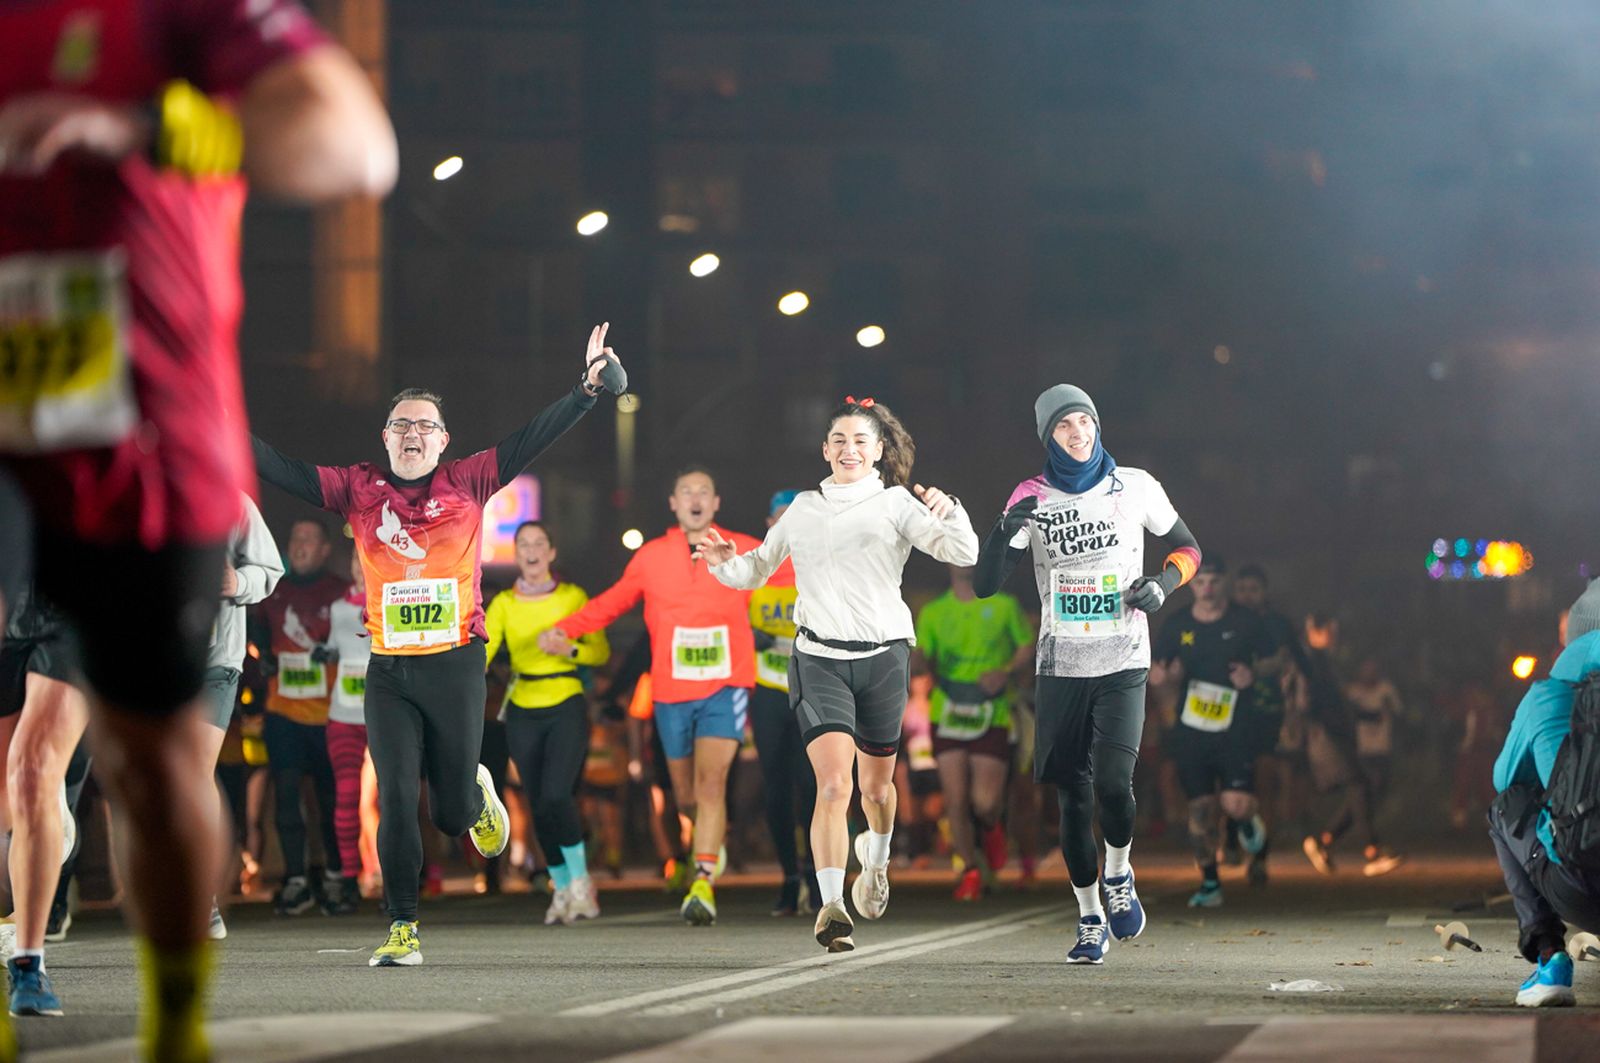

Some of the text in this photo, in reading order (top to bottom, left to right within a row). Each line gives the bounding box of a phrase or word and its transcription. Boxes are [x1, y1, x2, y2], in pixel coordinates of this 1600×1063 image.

[1035, 509, 1080, 530] San
[390, 533, 409, 550] 43
[1042, 520, 1115, 545] Juan de
[1059, 533, 1119, 556] Cruz
[1065, 577, 1096, 585] NOCHE DE
[1072, 585, 1097, 593] ANTÓN
[1059, 594, 1115, 614] 13025
[400, 604, 443, 625] 9172
[684, 646, 718, 662] 8140
